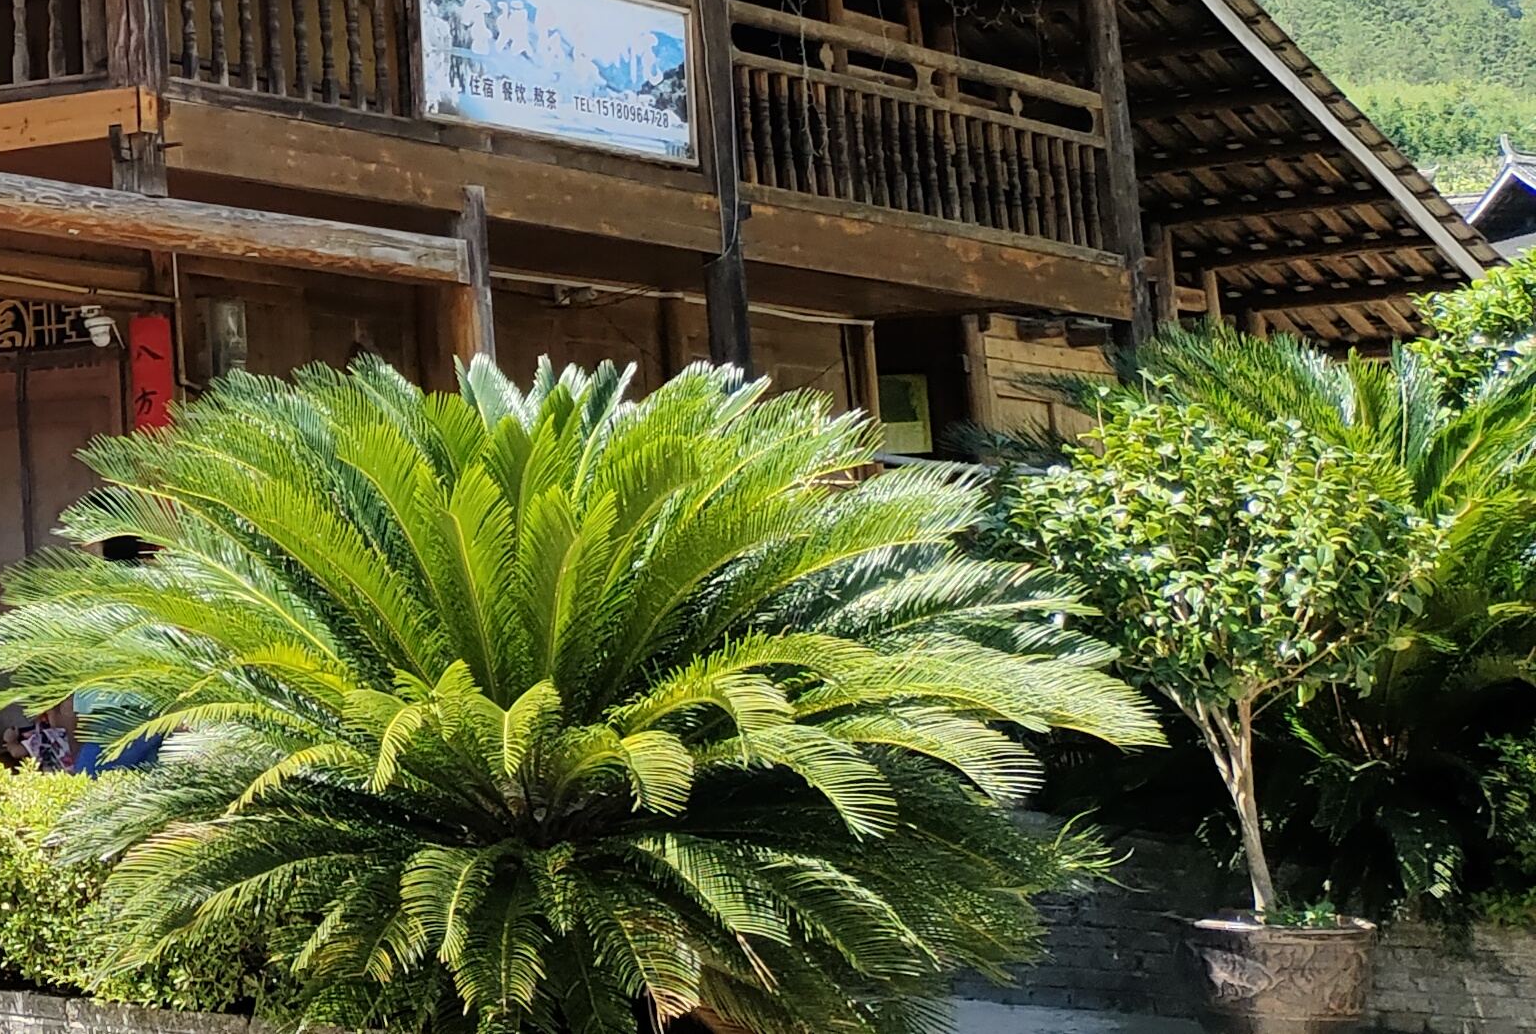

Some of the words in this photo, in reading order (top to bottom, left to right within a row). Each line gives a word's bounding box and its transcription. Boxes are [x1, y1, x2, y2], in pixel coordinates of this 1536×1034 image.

[469, 74, 494, 99] 住宿
[501, 79, 527, 104] 餐饮
[134, 344, 165, 416] 八方
